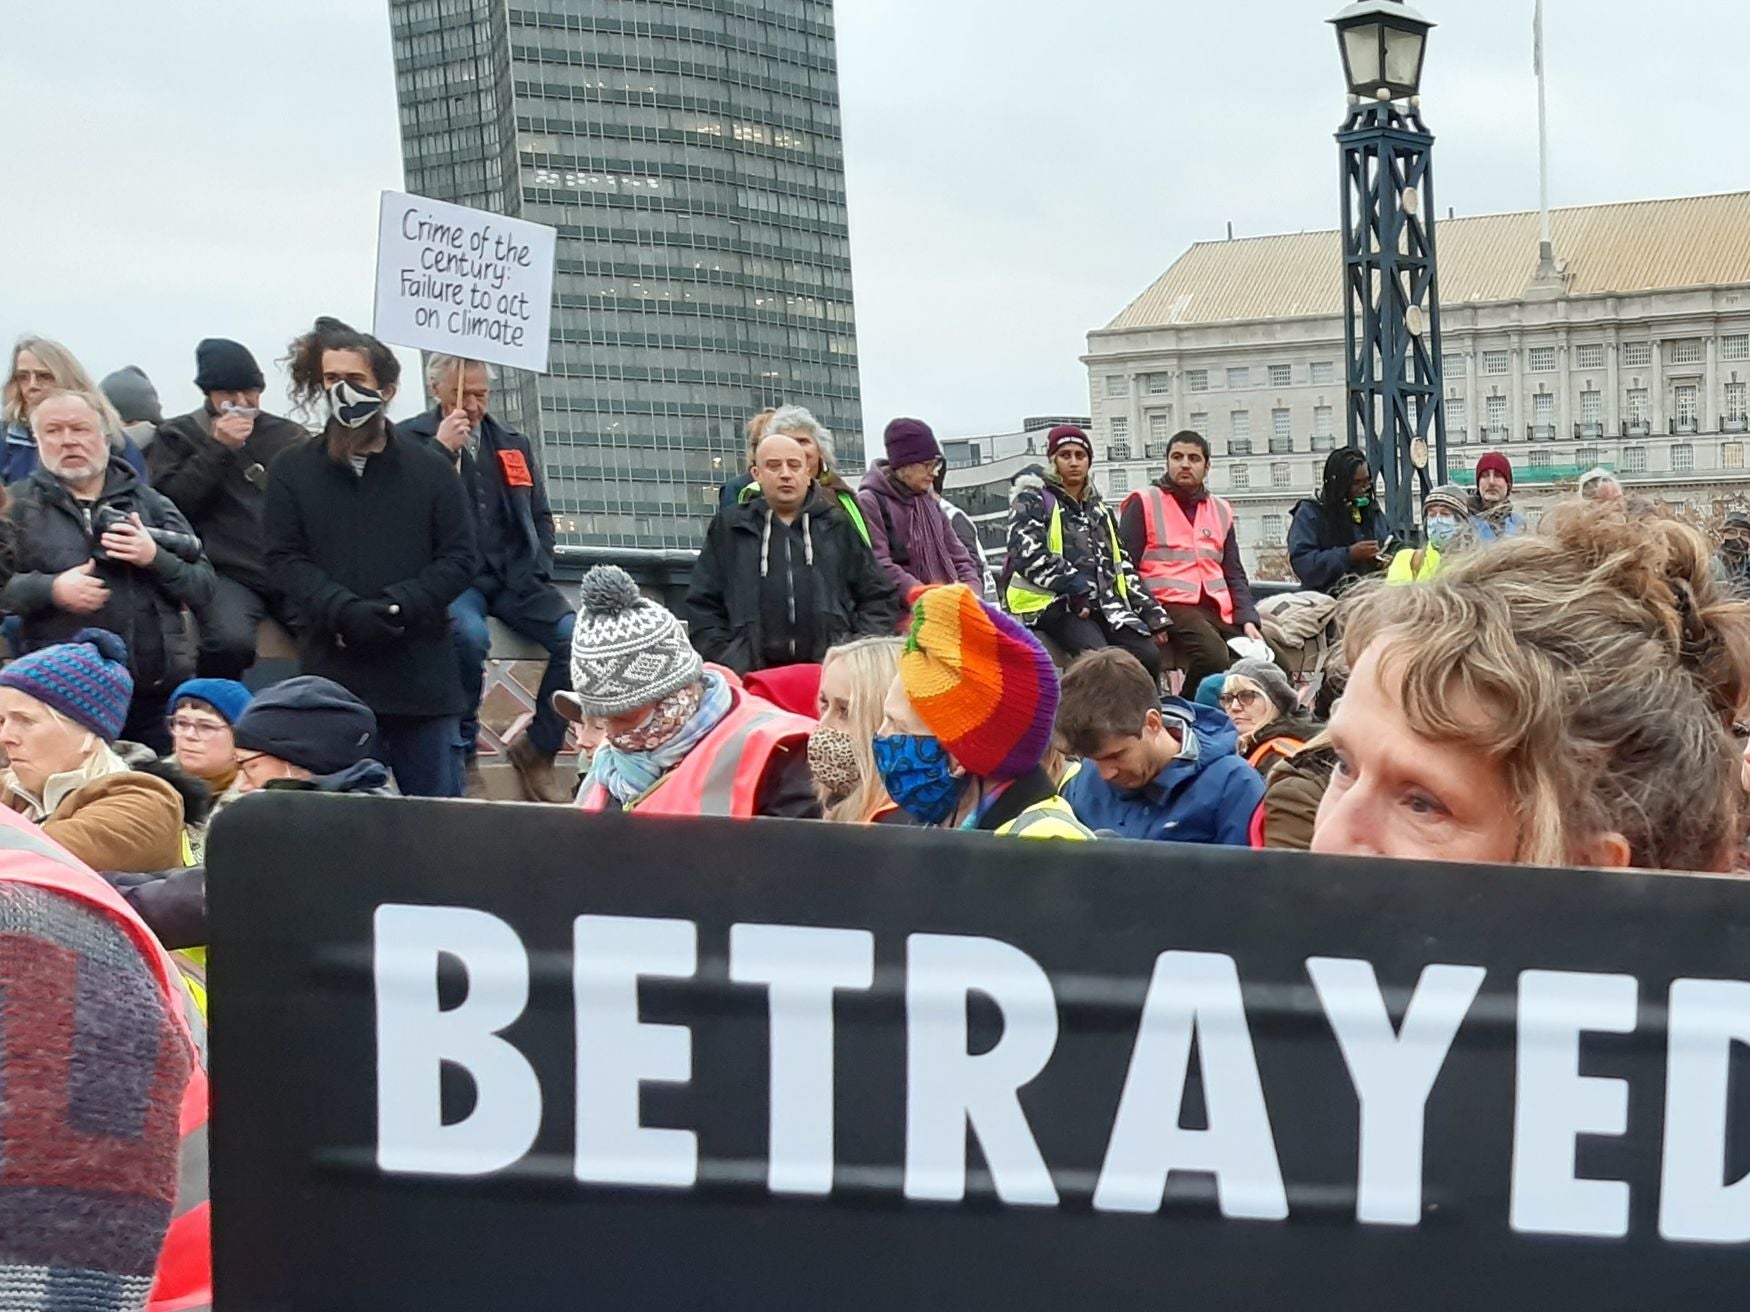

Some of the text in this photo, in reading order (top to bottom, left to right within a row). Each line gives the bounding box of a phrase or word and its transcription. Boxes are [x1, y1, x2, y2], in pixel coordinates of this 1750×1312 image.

[402, 208, 532, 267] Crime of the
[400, 268, 530, 320] Failure to act
[415, 306, 440, 329] on
